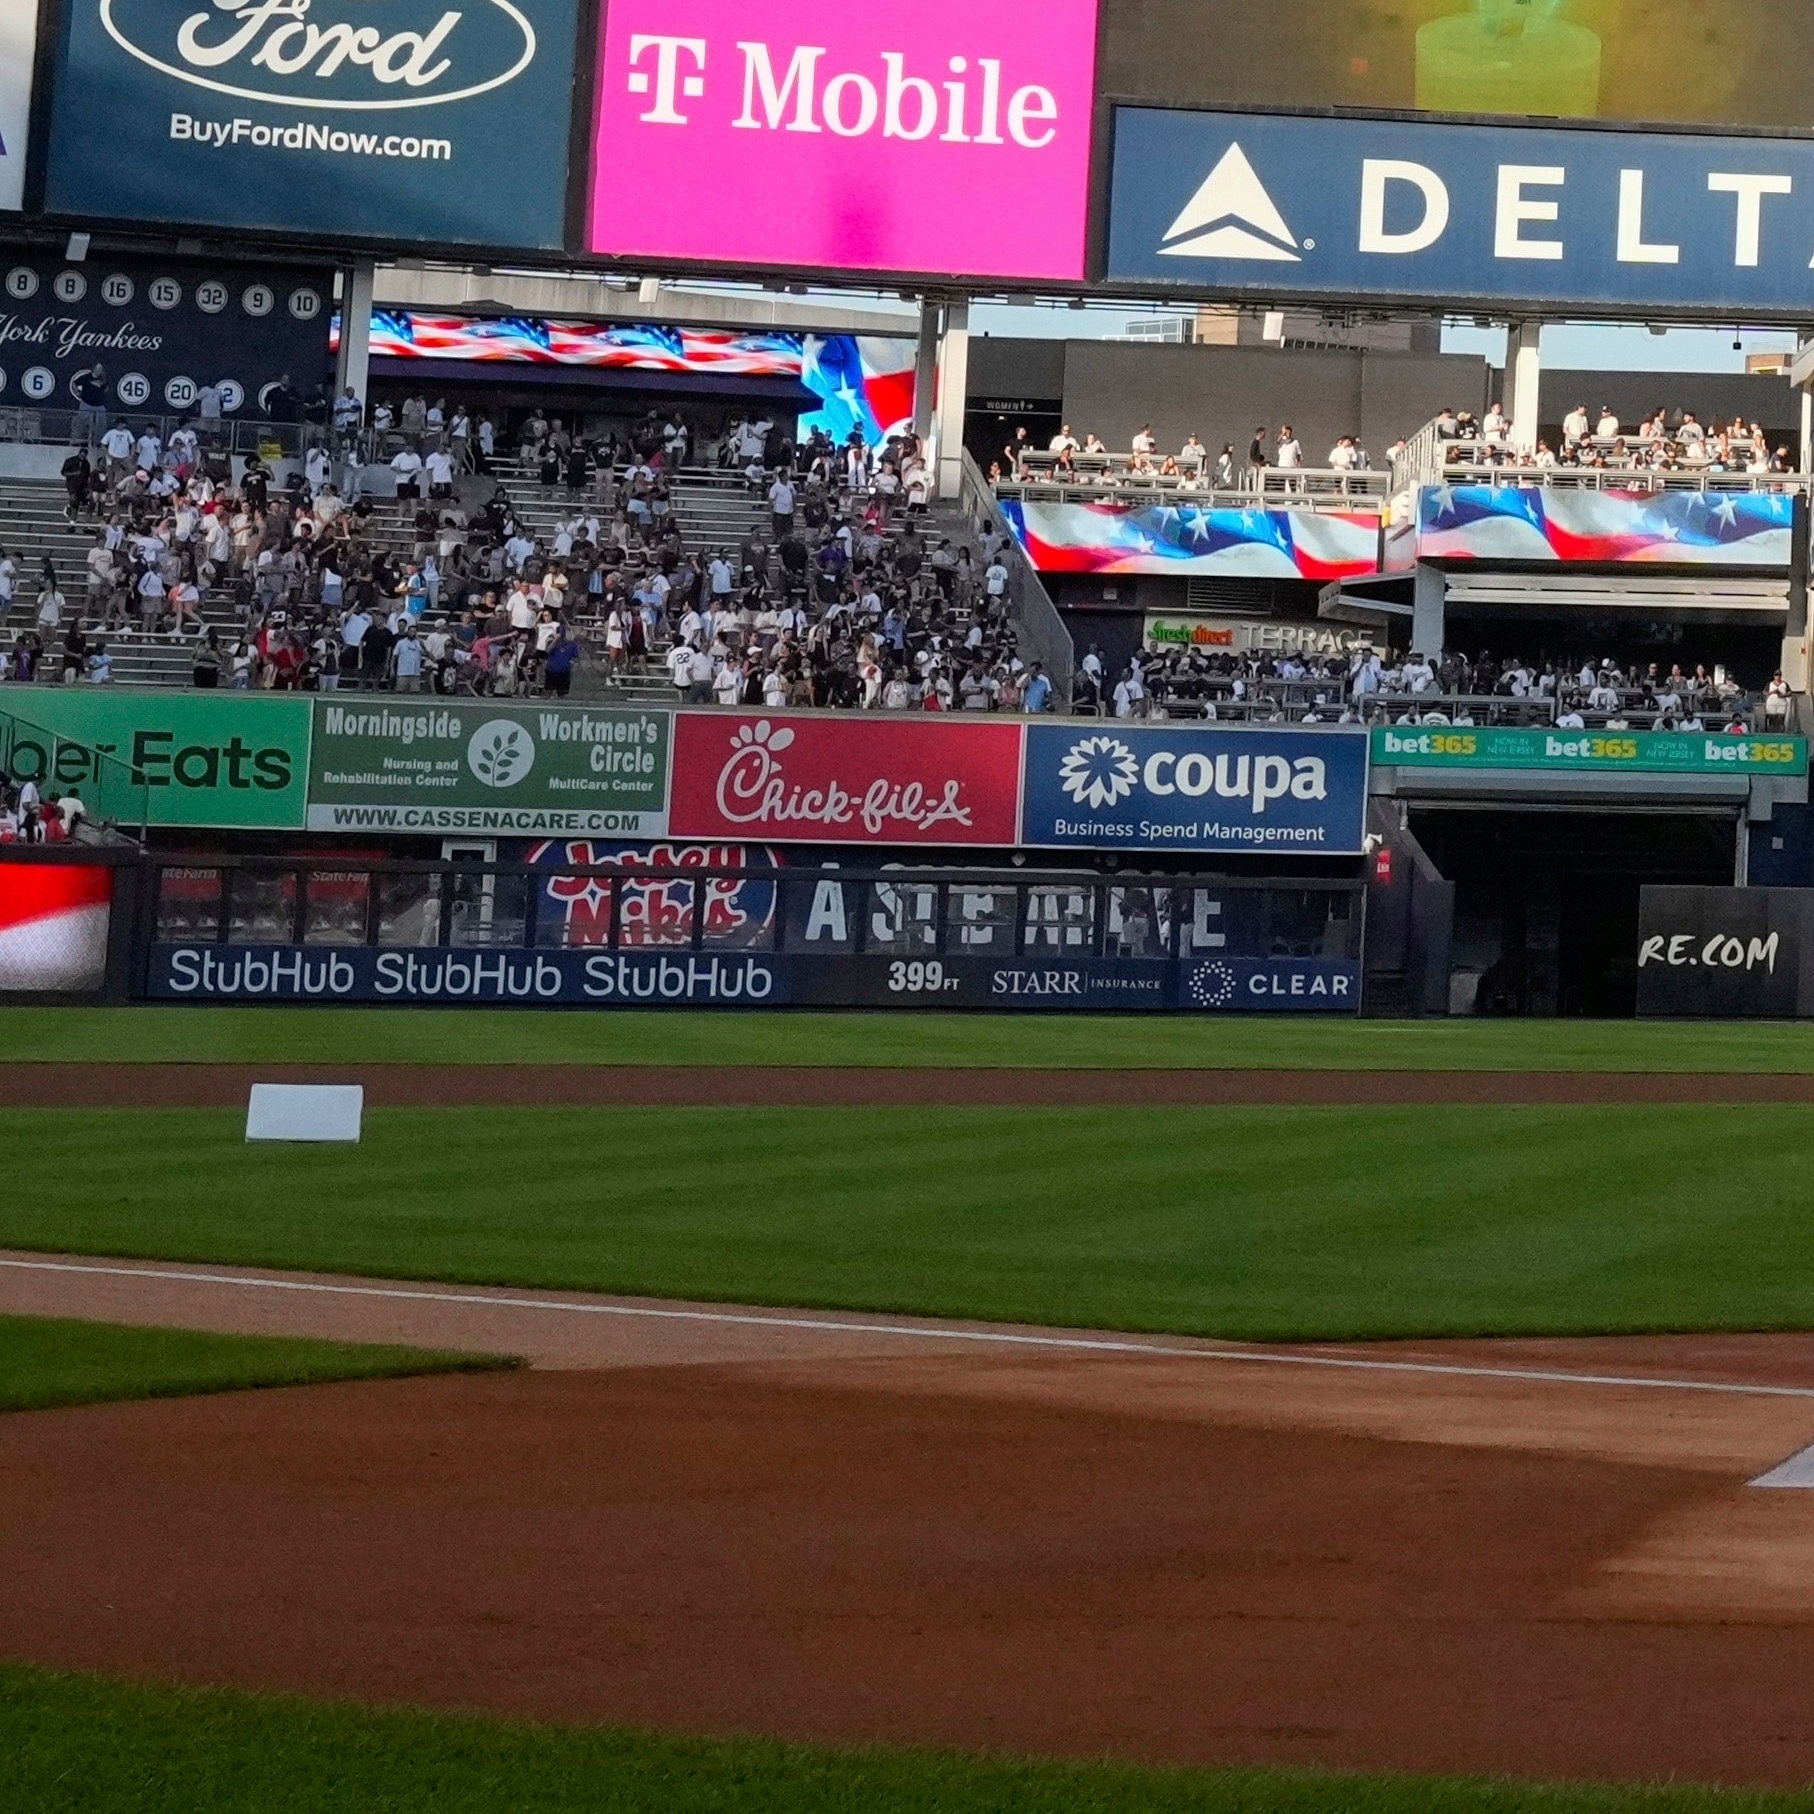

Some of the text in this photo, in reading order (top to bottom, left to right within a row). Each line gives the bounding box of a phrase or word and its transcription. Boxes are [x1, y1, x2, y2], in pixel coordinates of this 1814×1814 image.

[732, 41, 1058, 149] Mobile
[169, 112, 452, 161] BuyFordNow.com
[17, 274, 313, 312] 8 8 16 15 32 9 10
[54, 317, 163, 359] Yankees
[32, 375, 43, 391] 6
[122, 380, 145, 397] 46
[170, 384, 192, 400] 20
[676, 652, 690, 665] 22
[325, 707, 461, 744] Morningside
[539, 713, 658, 744] Workmen's
[0, 721, 292, 790] ber Eats
[1385, 732, 1476, 755] bet365
[1545, 736, 1637, 759] bet365
[1705, 739, 1794, 763] bet365
[383, 758, 459, 772] Nursing and
[590, 745, 655, 773] Circle
[324, 772, 459, 788] Rehabilitation Center
[549, 778, 654, 792] MultiCare Center
[716, 743, 972, 835] Chick-fil-A
[1143, 749, 1328, 814] coupa
[333, 808, 640, 832] WWW.CASSENACARE.COM
[1054, 818, 1326, 845] Business Spend Management
[1638, 932, 1780, 975] RE.COM
[168, 949, 773, 999] StubHub StubHub StubHub
[992, 969, 1161, 995] STARR INSURANCE
[1248, 975, 1349, 997] CLEAR
